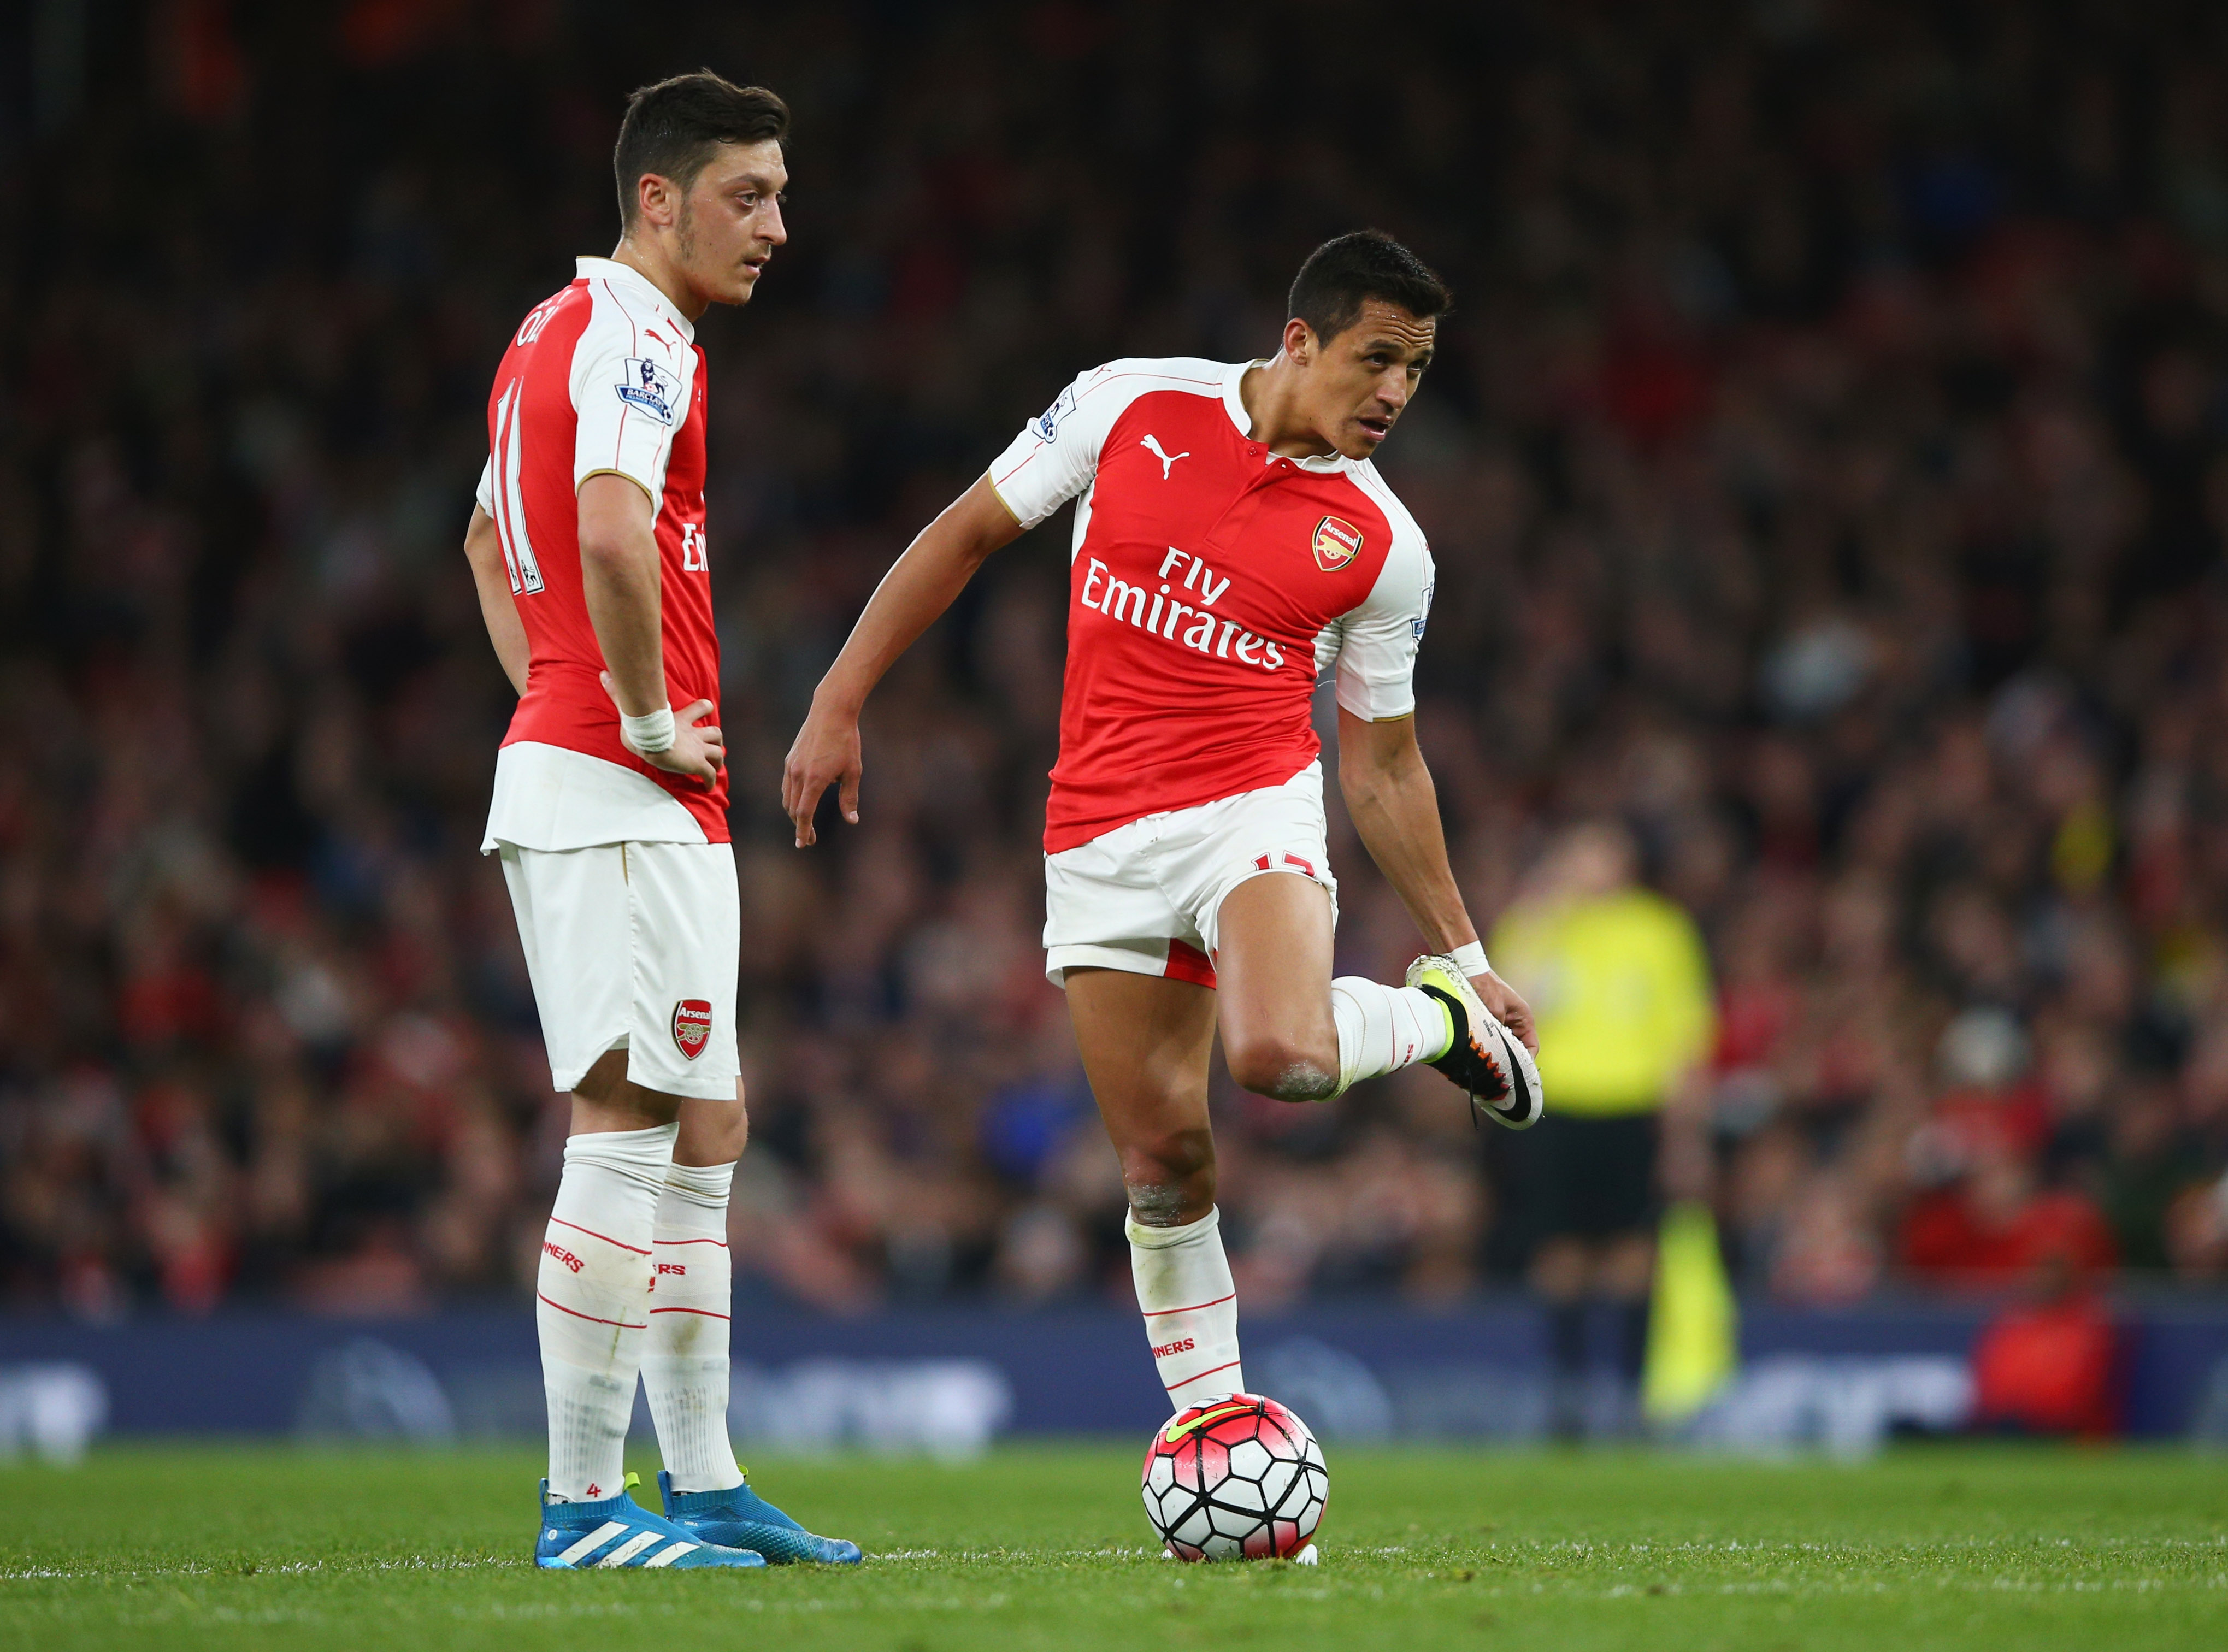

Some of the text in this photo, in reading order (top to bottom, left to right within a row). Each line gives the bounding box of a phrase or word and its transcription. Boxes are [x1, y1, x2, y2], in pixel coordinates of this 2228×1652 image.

[626, 388, 665, 410] BARCLAYS
[1323, 522, 1358, 547] Arsenal
[1158, 546, 1231, 606] Fly
[1081, 556, 1286, 670] Emirates
[679, 1007, 711, 1020] Arsenal
[586, 1482, 602, 1498] 4
